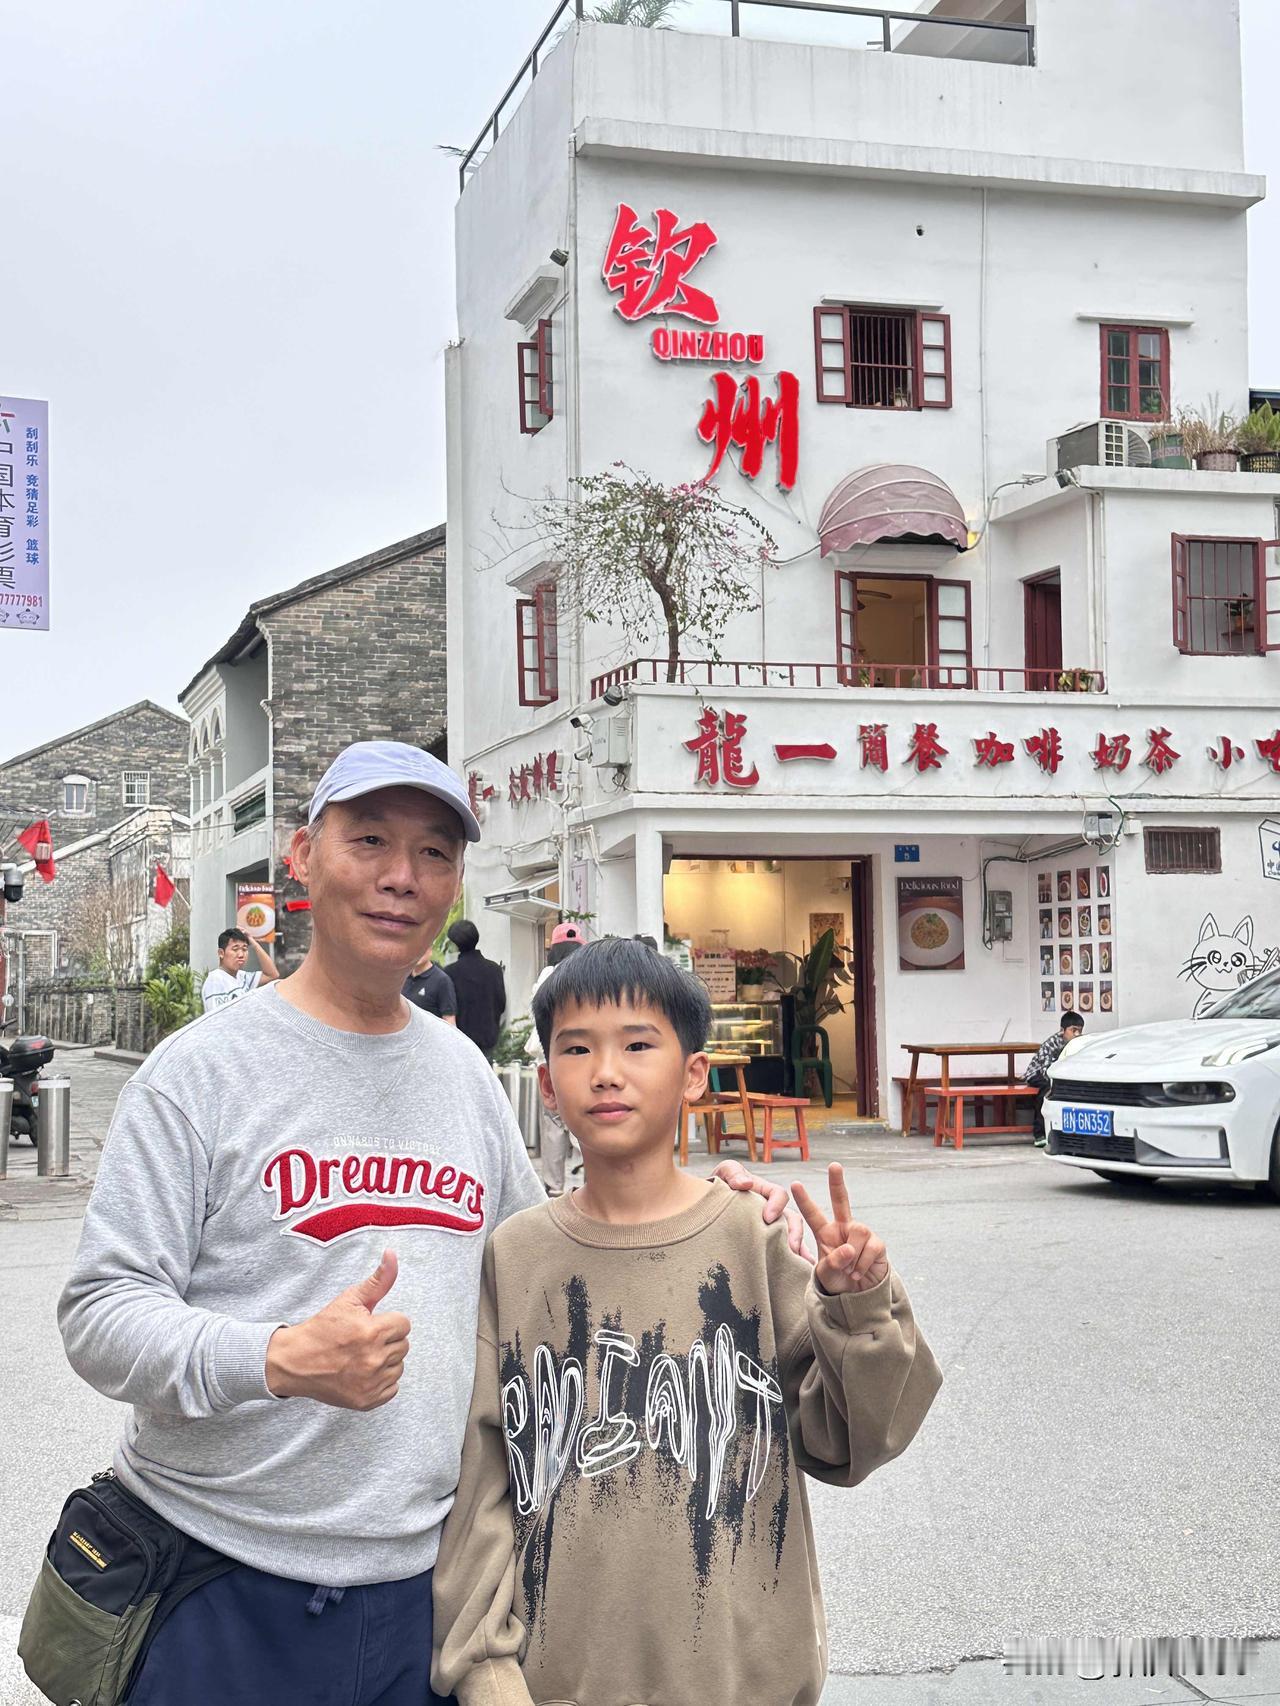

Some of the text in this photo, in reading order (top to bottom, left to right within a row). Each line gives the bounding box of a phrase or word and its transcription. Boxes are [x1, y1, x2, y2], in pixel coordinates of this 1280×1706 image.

[602, 202, 719, 324] 钦
[651, 328, 765, 362] QINZHOU
[698, 371, 799, 490] 州
[25, 427, 40, 565] 刮刮乐 竞猜足彩 篮球
[682, 705, 837, 787] 龍一
[971, 727, 1064, 776] 咖啡
[1090, 726, 1181, 775] 奶茶
[264, 1149, 484, 1216] Dreamers
